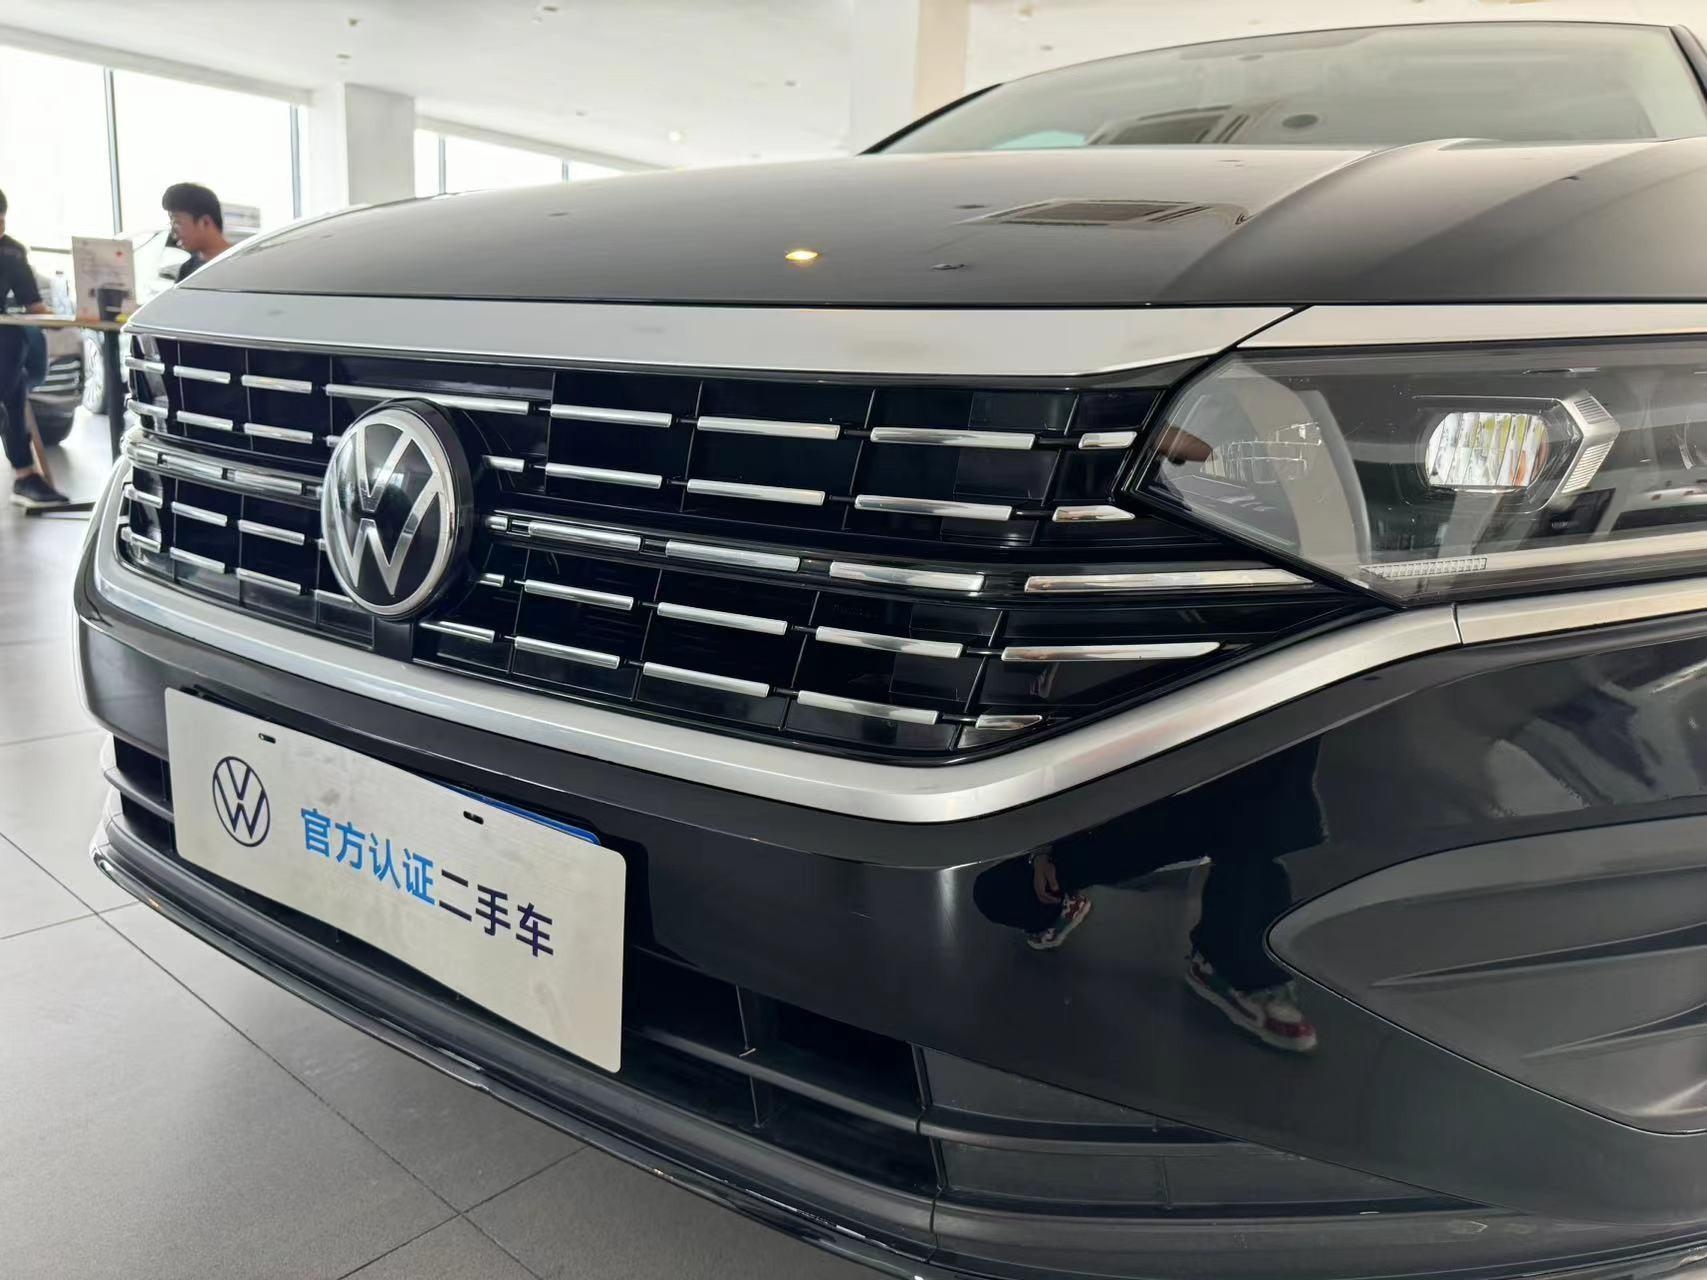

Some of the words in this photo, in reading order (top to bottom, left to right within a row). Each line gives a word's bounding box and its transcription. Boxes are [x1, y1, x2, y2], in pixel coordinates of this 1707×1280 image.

[301, 808, 554, 957] 官方认证二手车
